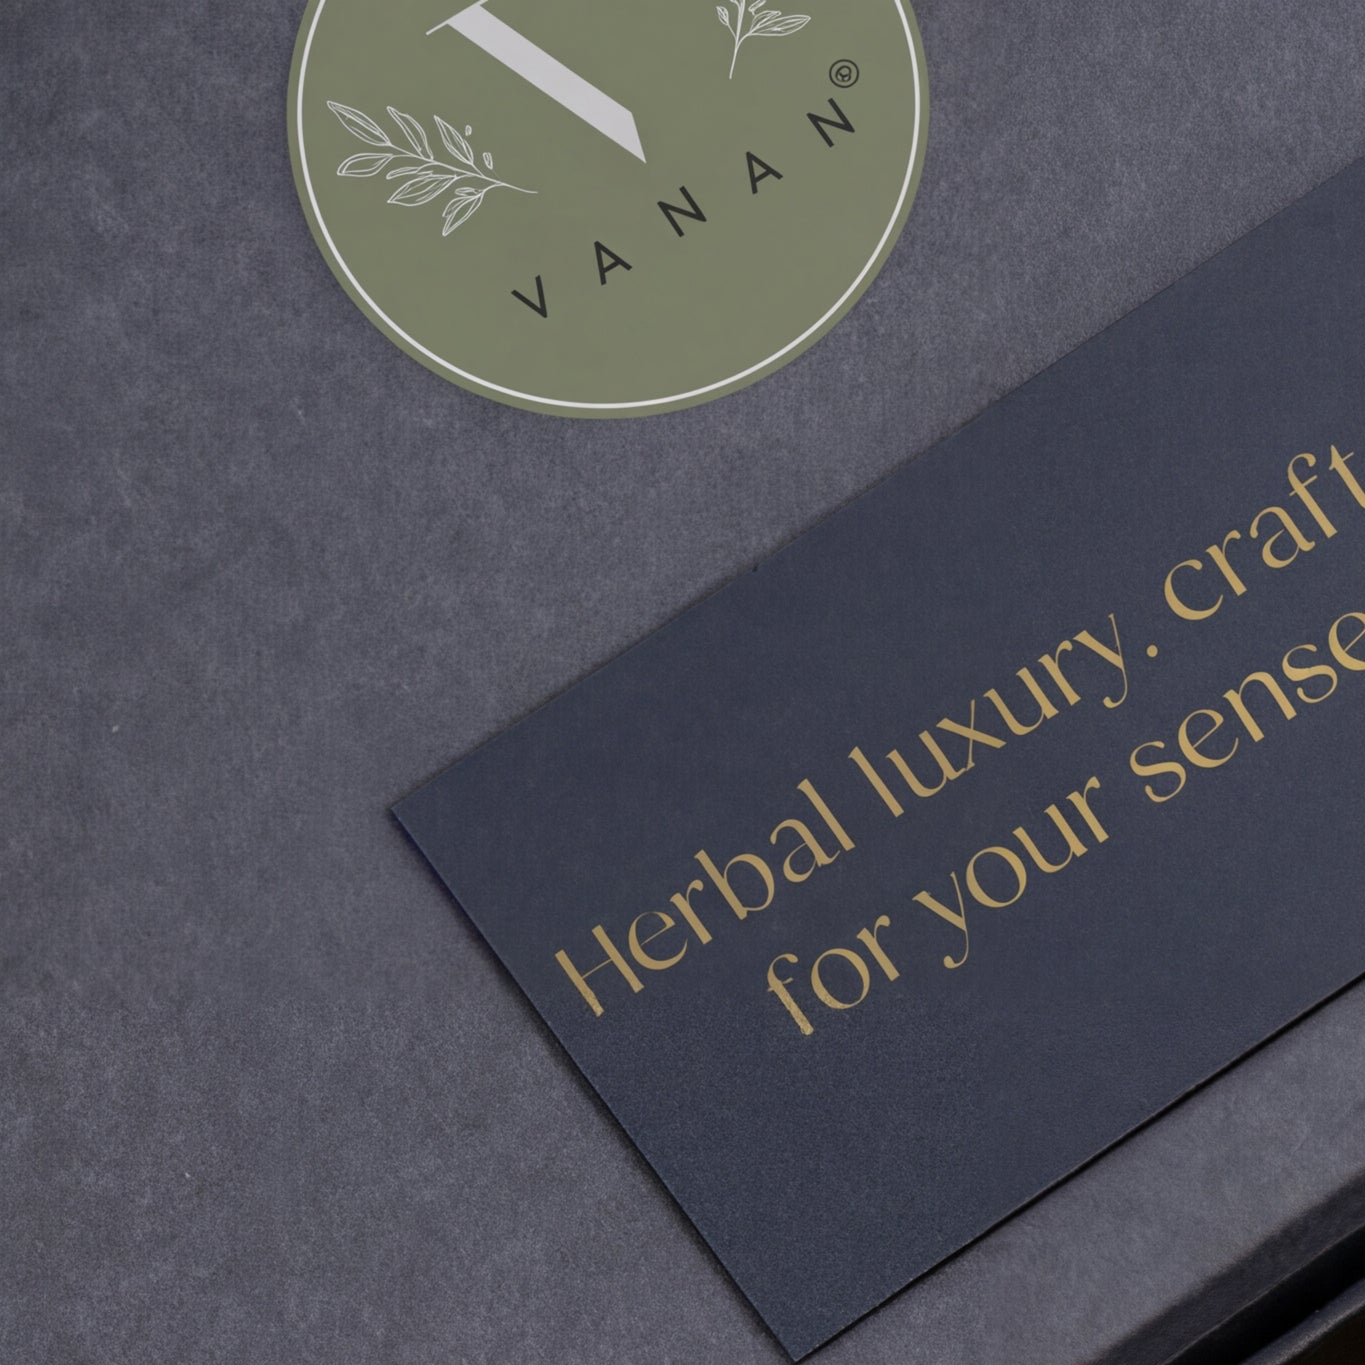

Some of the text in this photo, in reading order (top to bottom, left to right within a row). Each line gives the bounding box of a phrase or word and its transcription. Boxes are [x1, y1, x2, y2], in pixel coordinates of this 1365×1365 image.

[555, 778, 855, 1017] Herbal
[849, 615, 1159, 817] luxury.
[767, 914, 900, 1035] for
[914, 776, 1109, 969] your
